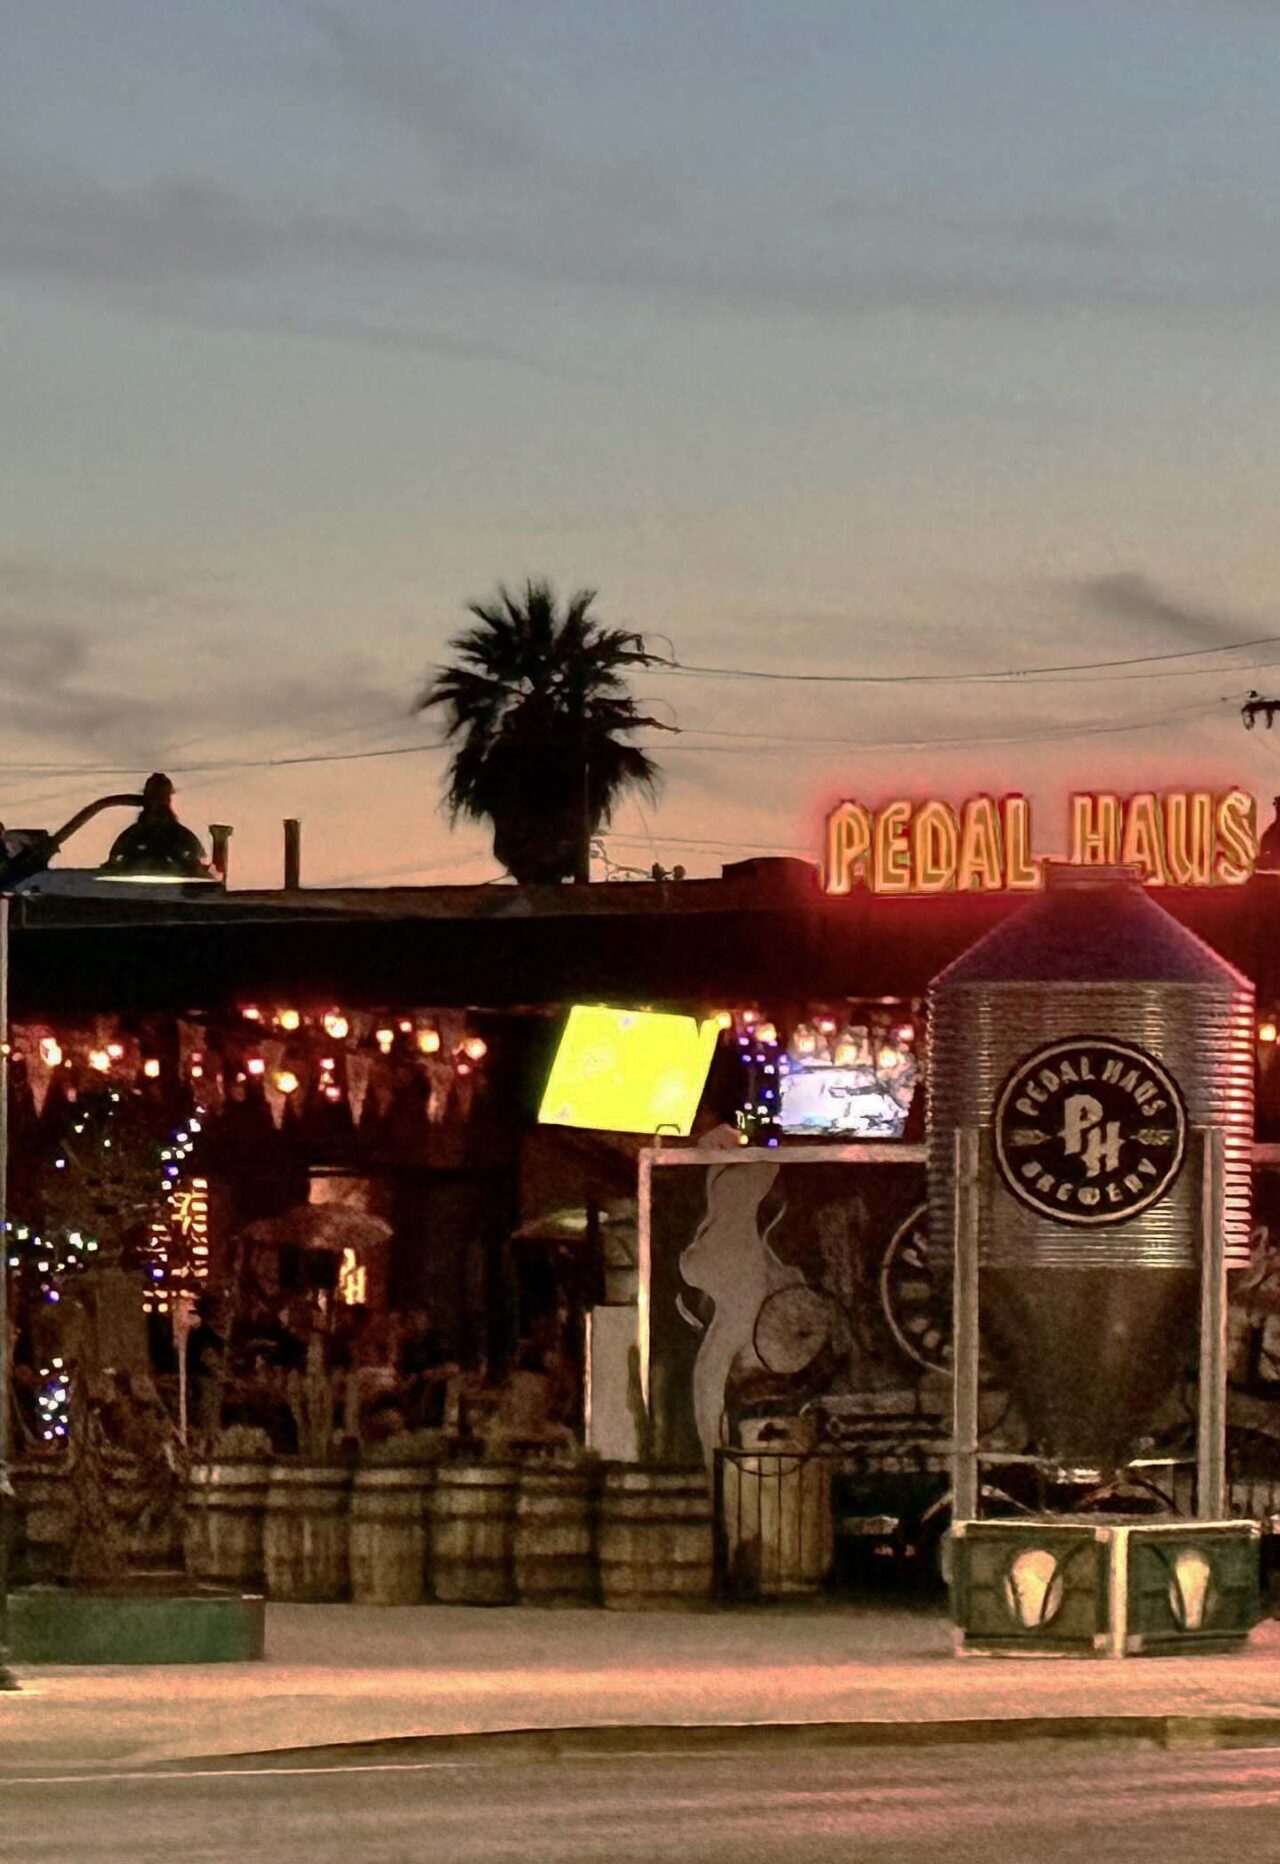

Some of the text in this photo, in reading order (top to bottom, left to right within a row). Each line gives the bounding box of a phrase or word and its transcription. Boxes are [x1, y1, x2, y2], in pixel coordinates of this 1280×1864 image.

[824, 796, 1041, 894] PEDAL
[1070, 788, 1257, 886] HAUS
[1016, 1055, 1168, 1116] PEDAL HAUS
